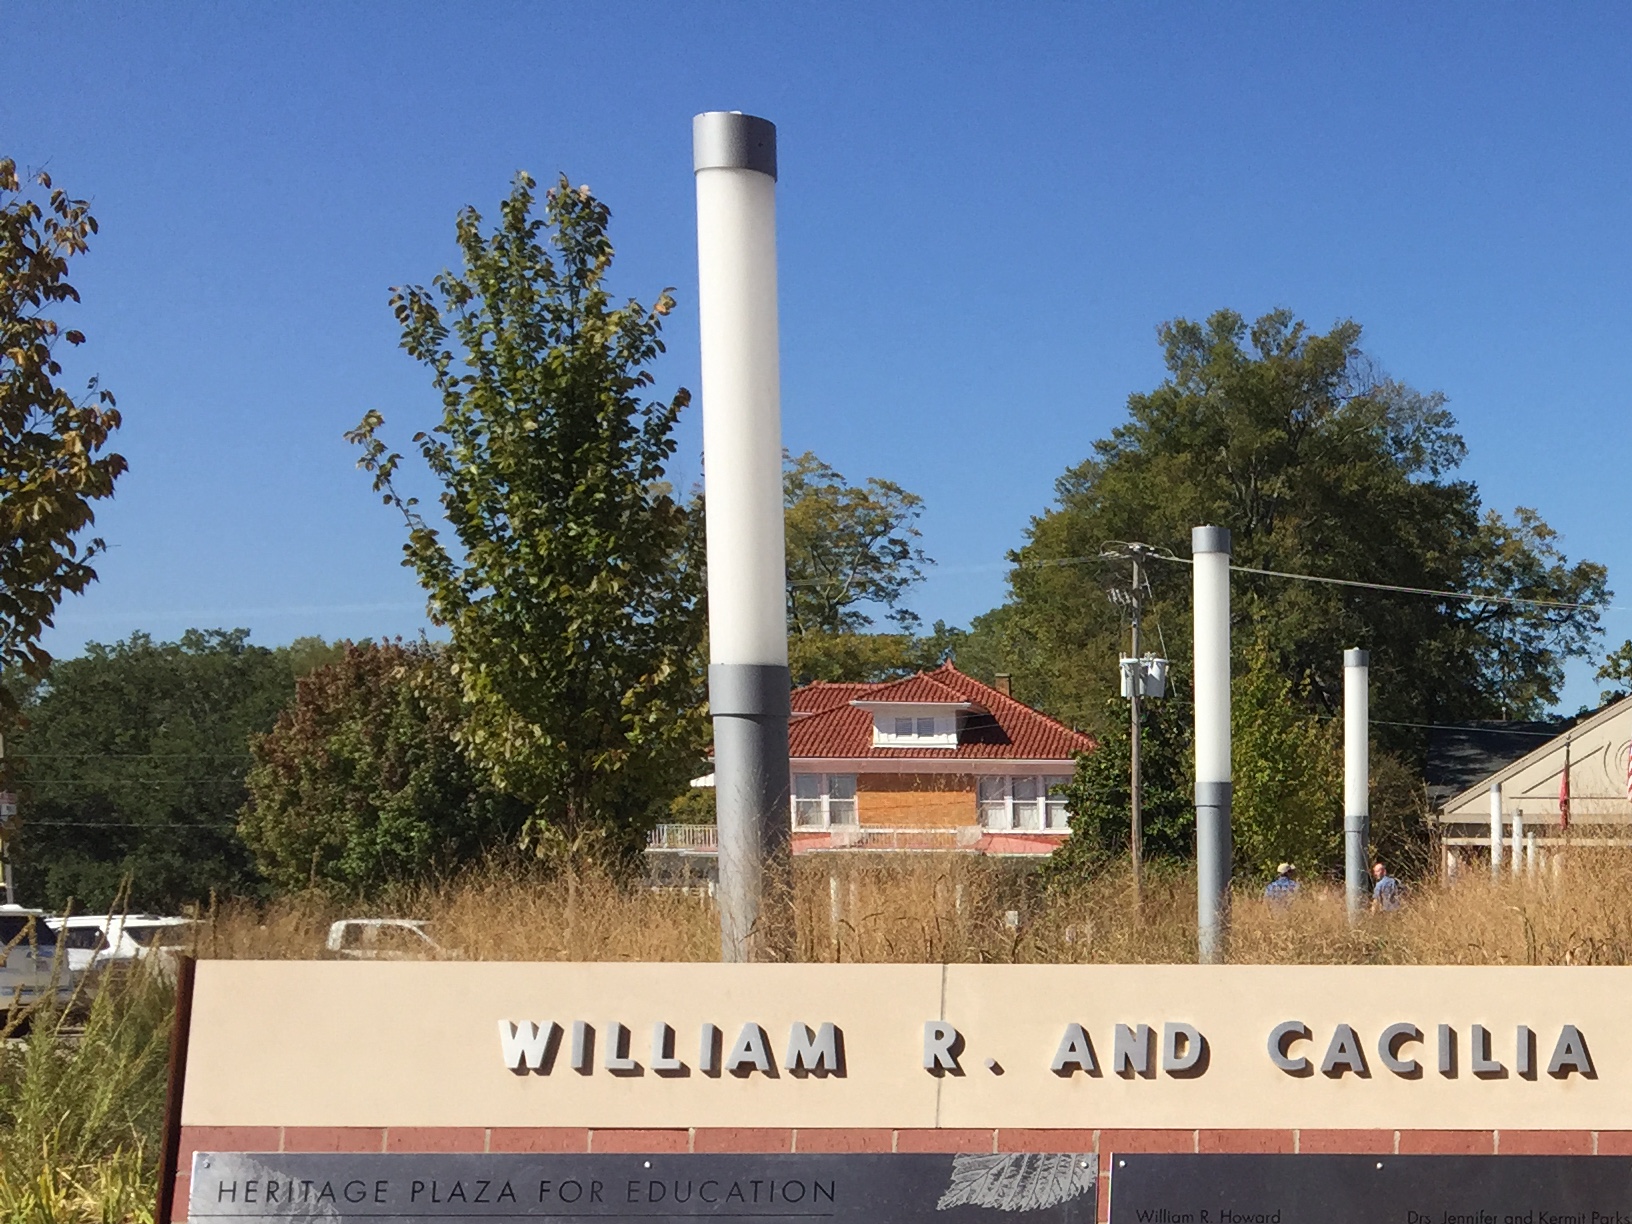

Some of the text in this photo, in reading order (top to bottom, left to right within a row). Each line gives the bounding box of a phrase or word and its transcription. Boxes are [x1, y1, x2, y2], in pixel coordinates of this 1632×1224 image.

[498, 1020, 846, 1078] WILLIAM
[923, 1021, 1004, 1078] R.
[1051, 1022, 1210, 1079] AND
[1267, 1021, 1598, 1080] CACILIA
[217, 1179, 837, 1204] HERITAGE PLAZA FOR EDUCATION
[1136, 1209, 1281, 1224] William R. Howard
[1441, 1210, 1497, 1224] Jennifer
[1504, 1210, 1533, 1224] and
[1538, 1211, 1586, 1224] Kermit
